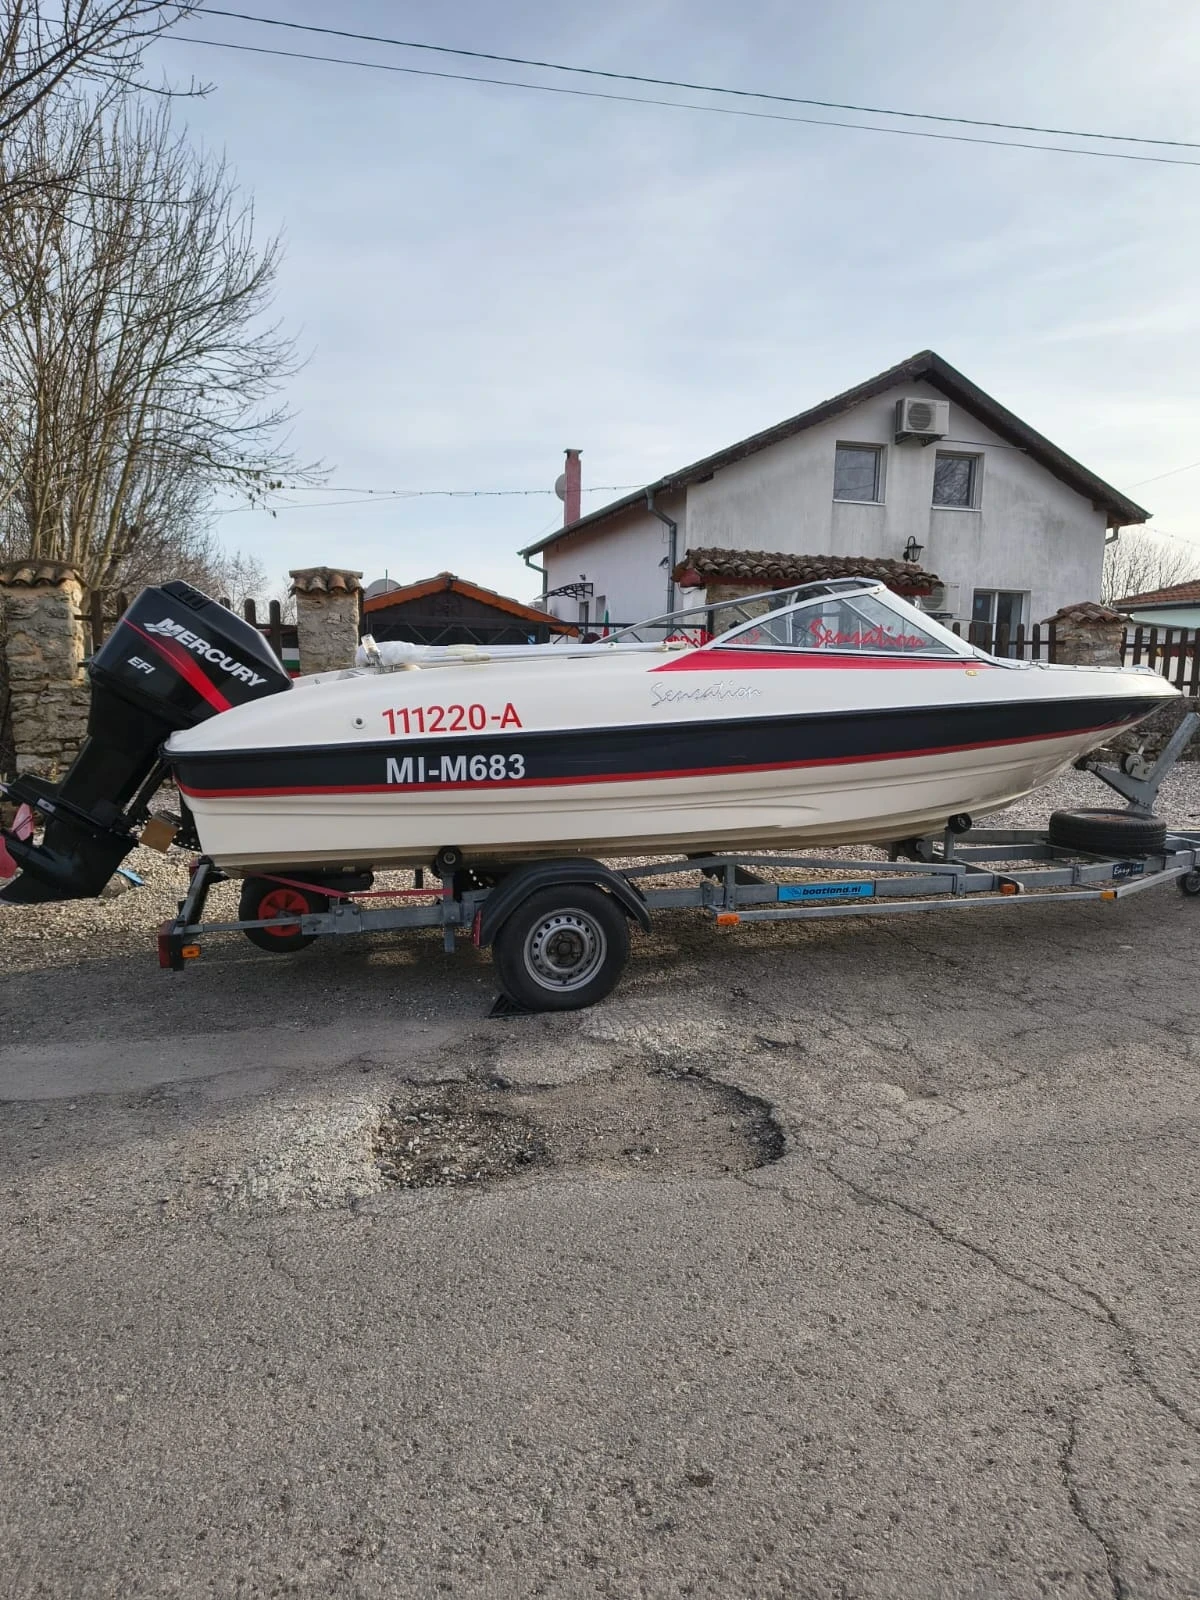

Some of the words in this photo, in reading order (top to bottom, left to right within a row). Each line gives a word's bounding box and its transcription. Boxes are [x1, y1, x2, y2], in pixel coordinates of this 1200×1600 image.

[810, 618, 926, 648] Sensation
[128, 656, 156, 674] EFI
[144, 618, 267, 687] MERCURY
[651, 681, 762, 706] Sensation
[382, 703, 522, 734] 111220-A
[387, 753, 525, 784] MI-M683
[803, 886, 861, 896] boatland.nl
